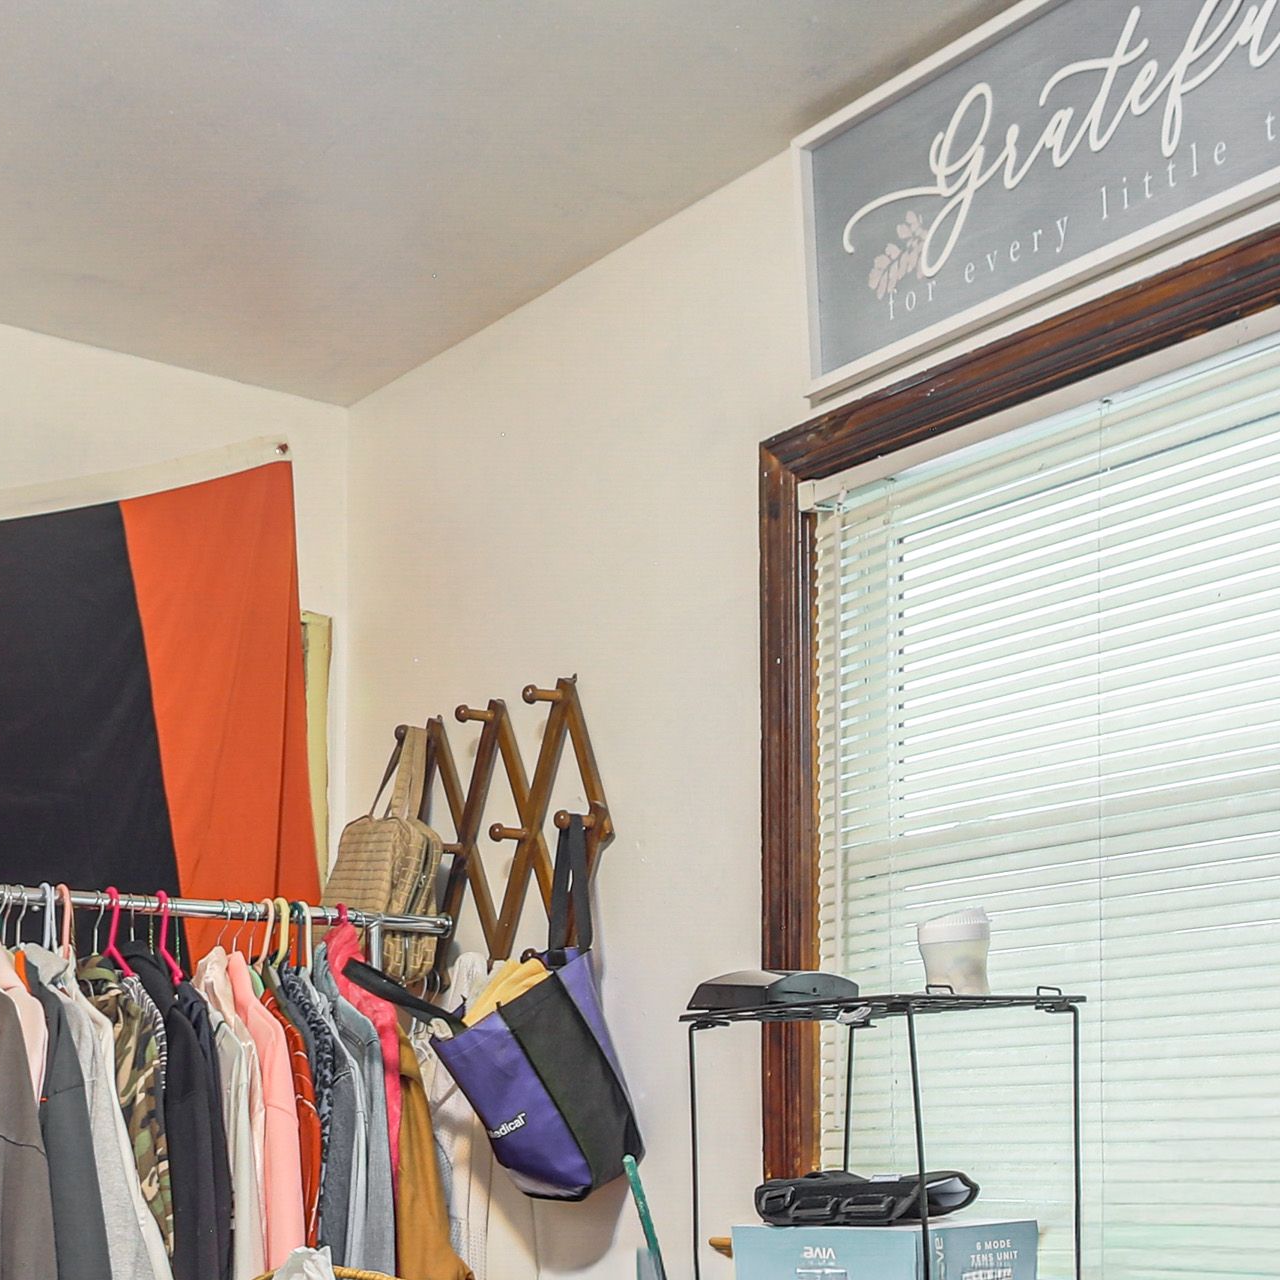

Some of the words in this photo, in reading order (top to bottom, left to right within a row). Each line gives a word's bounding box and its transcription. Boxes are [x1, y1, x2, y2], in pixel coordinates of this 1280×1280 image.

[887, 278, 937, 321] for
[964, 214, 1069, 284] every
[1100, 141, 1227, 221] little
[488, 1112, 527, 1138] edical
[984, 1239, 1012, 1250] MODE
[996, 1250, 1019, 1261] UNIT
